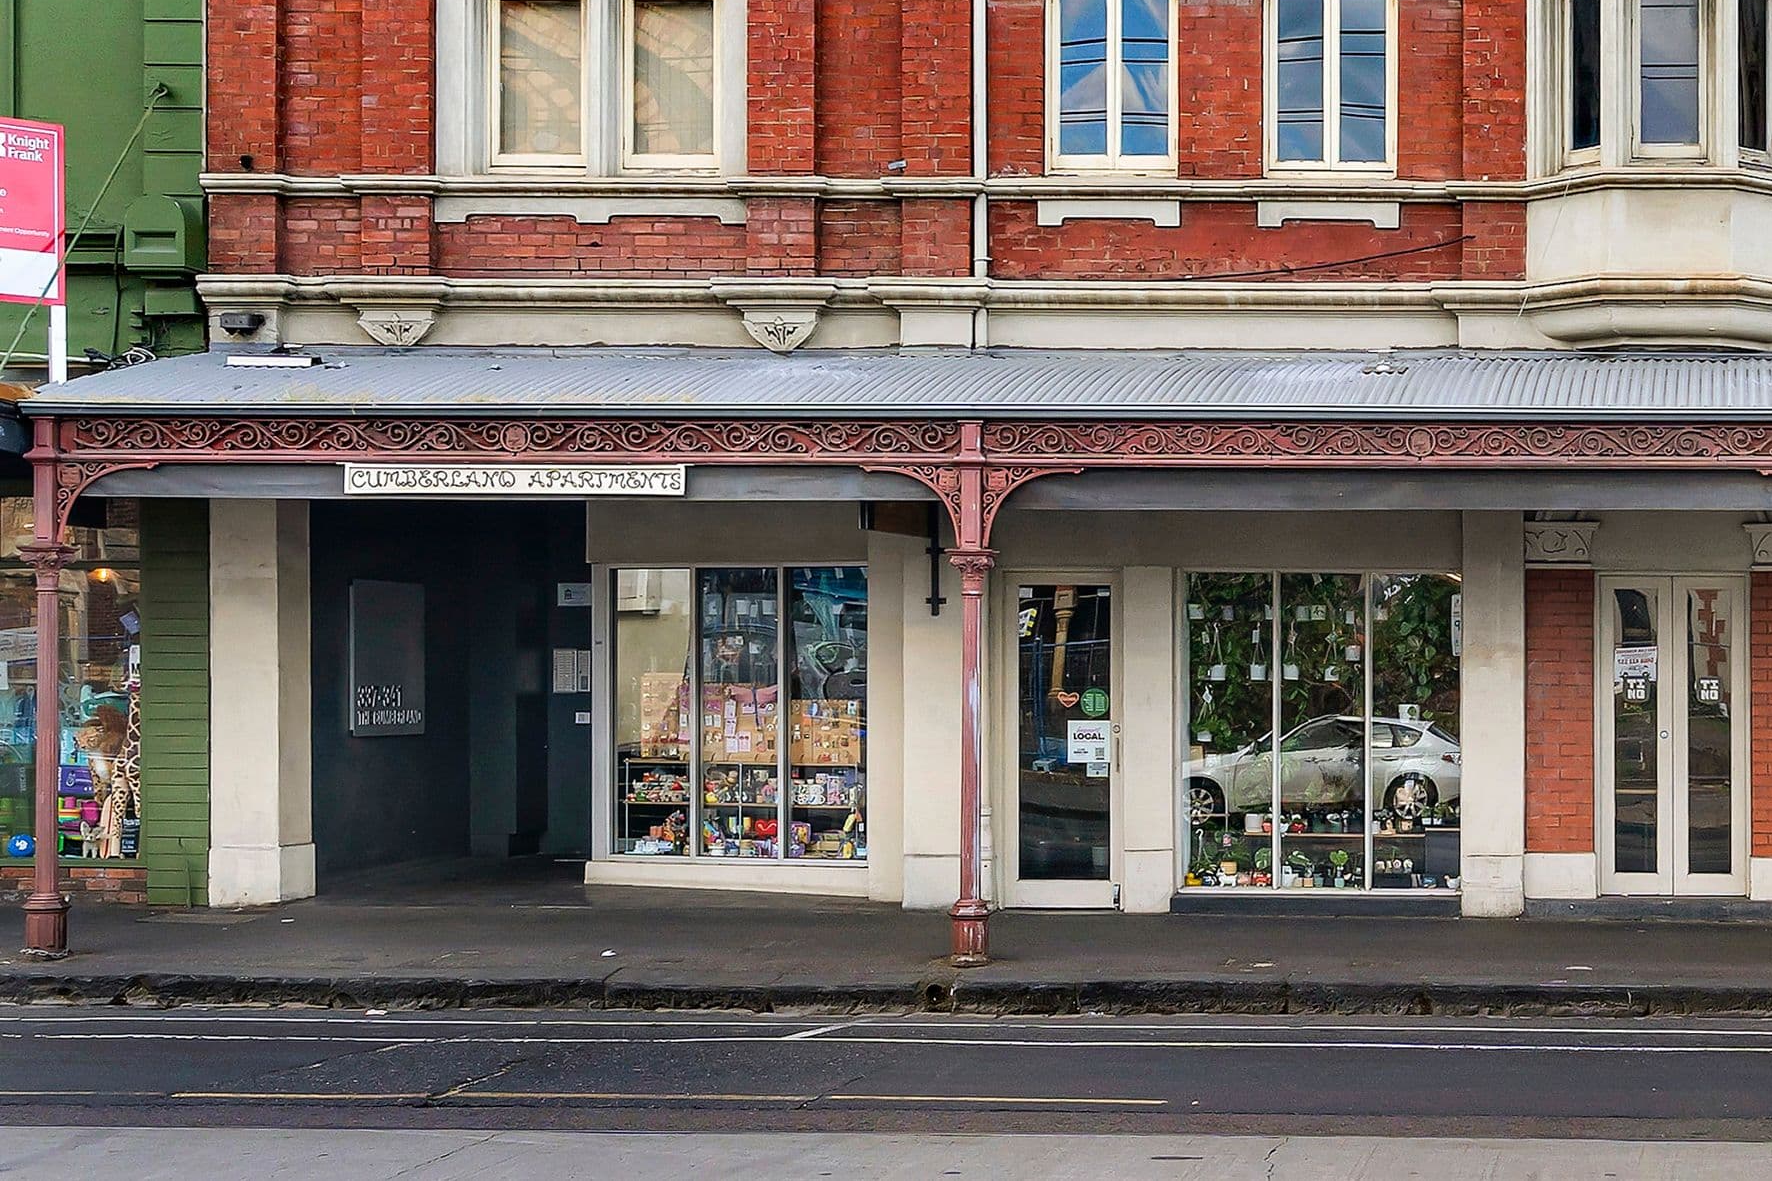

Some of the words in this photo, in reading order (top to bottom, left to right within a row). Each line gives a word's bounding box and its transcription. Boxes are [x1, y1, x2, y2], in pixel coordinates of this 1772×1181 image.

[7, 132, 50, 150] Knight
[7, 146, 44, 162] Frank
[351, 470, 516, 489] CUMBERLAND
[528, 470, 681, 490] APARTMENTS
